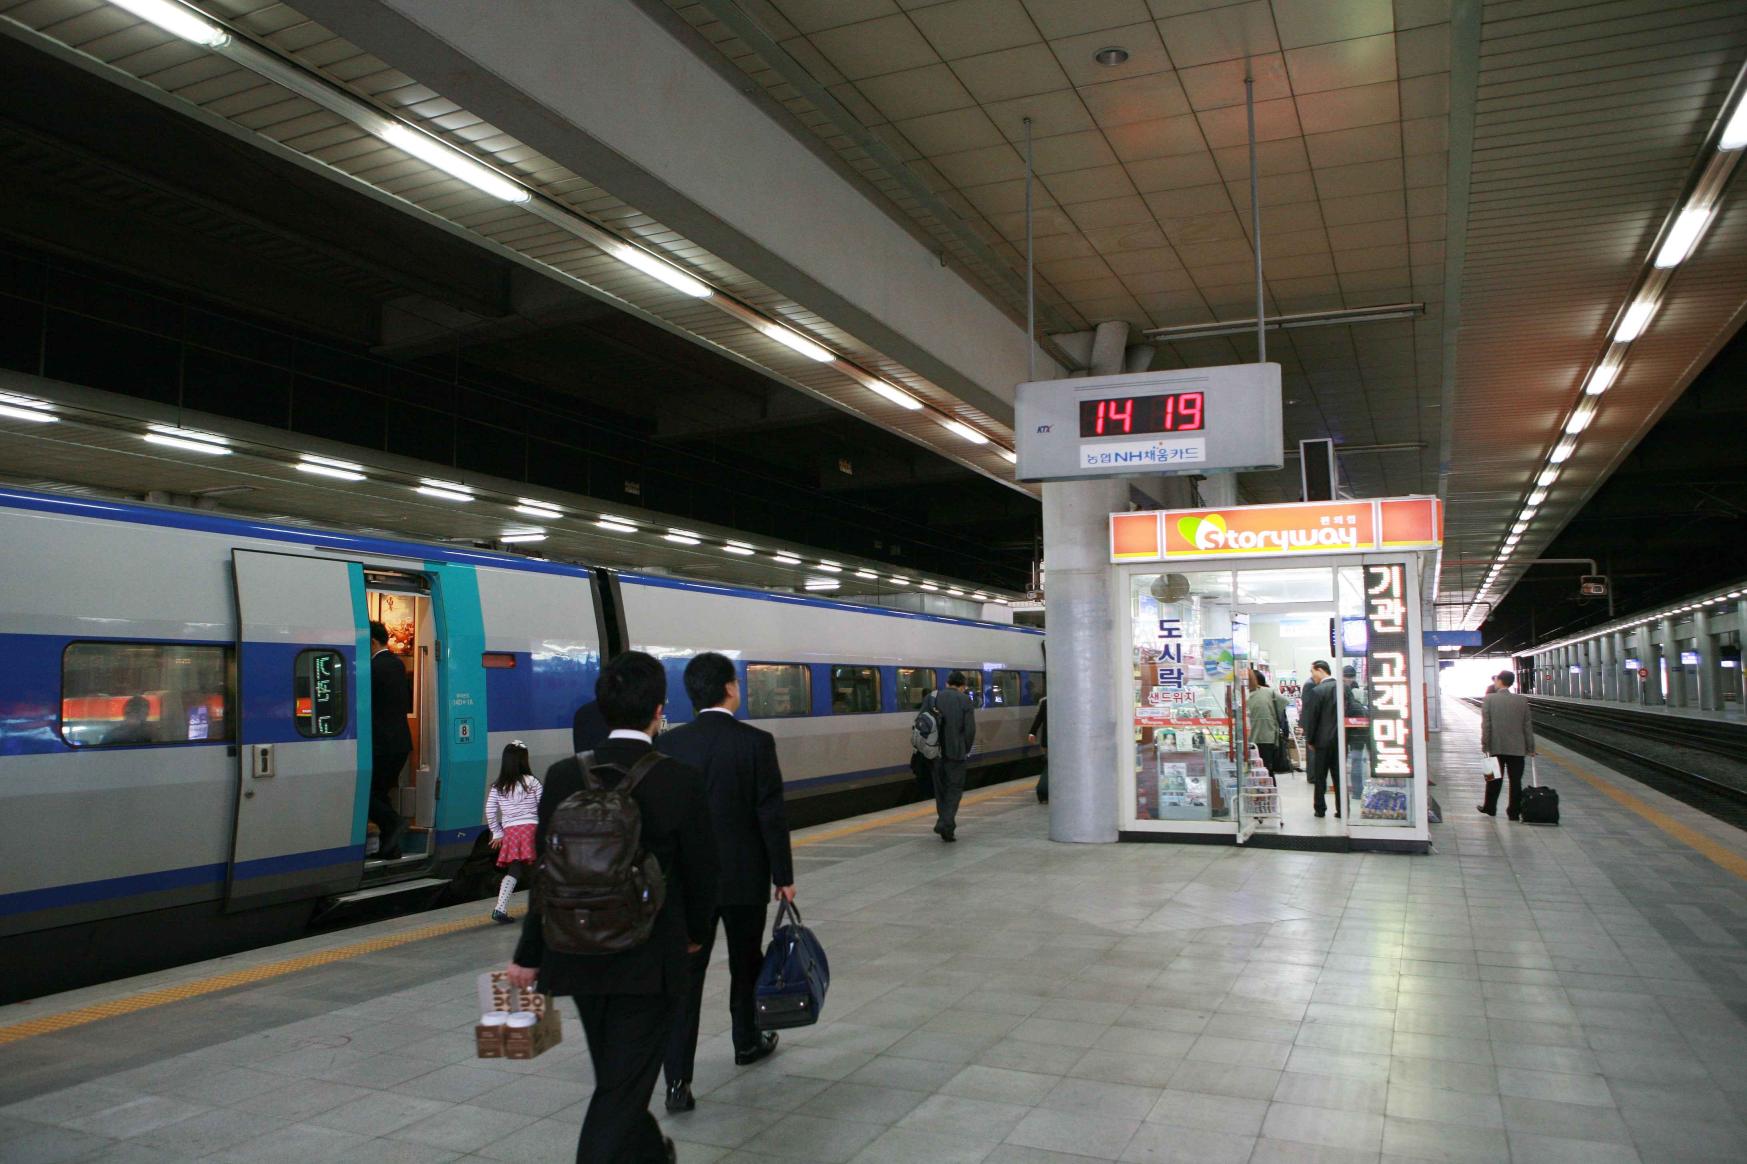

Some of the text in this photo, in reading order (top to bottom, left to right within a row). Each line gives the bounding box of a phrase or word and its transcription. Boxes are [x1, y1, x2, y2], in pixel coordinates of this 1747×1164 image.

[1037, 424, 1053, 434] KTX
[1095, 392, 1203, 434] 14 19
[1368, 565, 1407, 632] 기관
[1158, 619, 1184, 689] 도시락
[462, 725, 467, 736] 8
